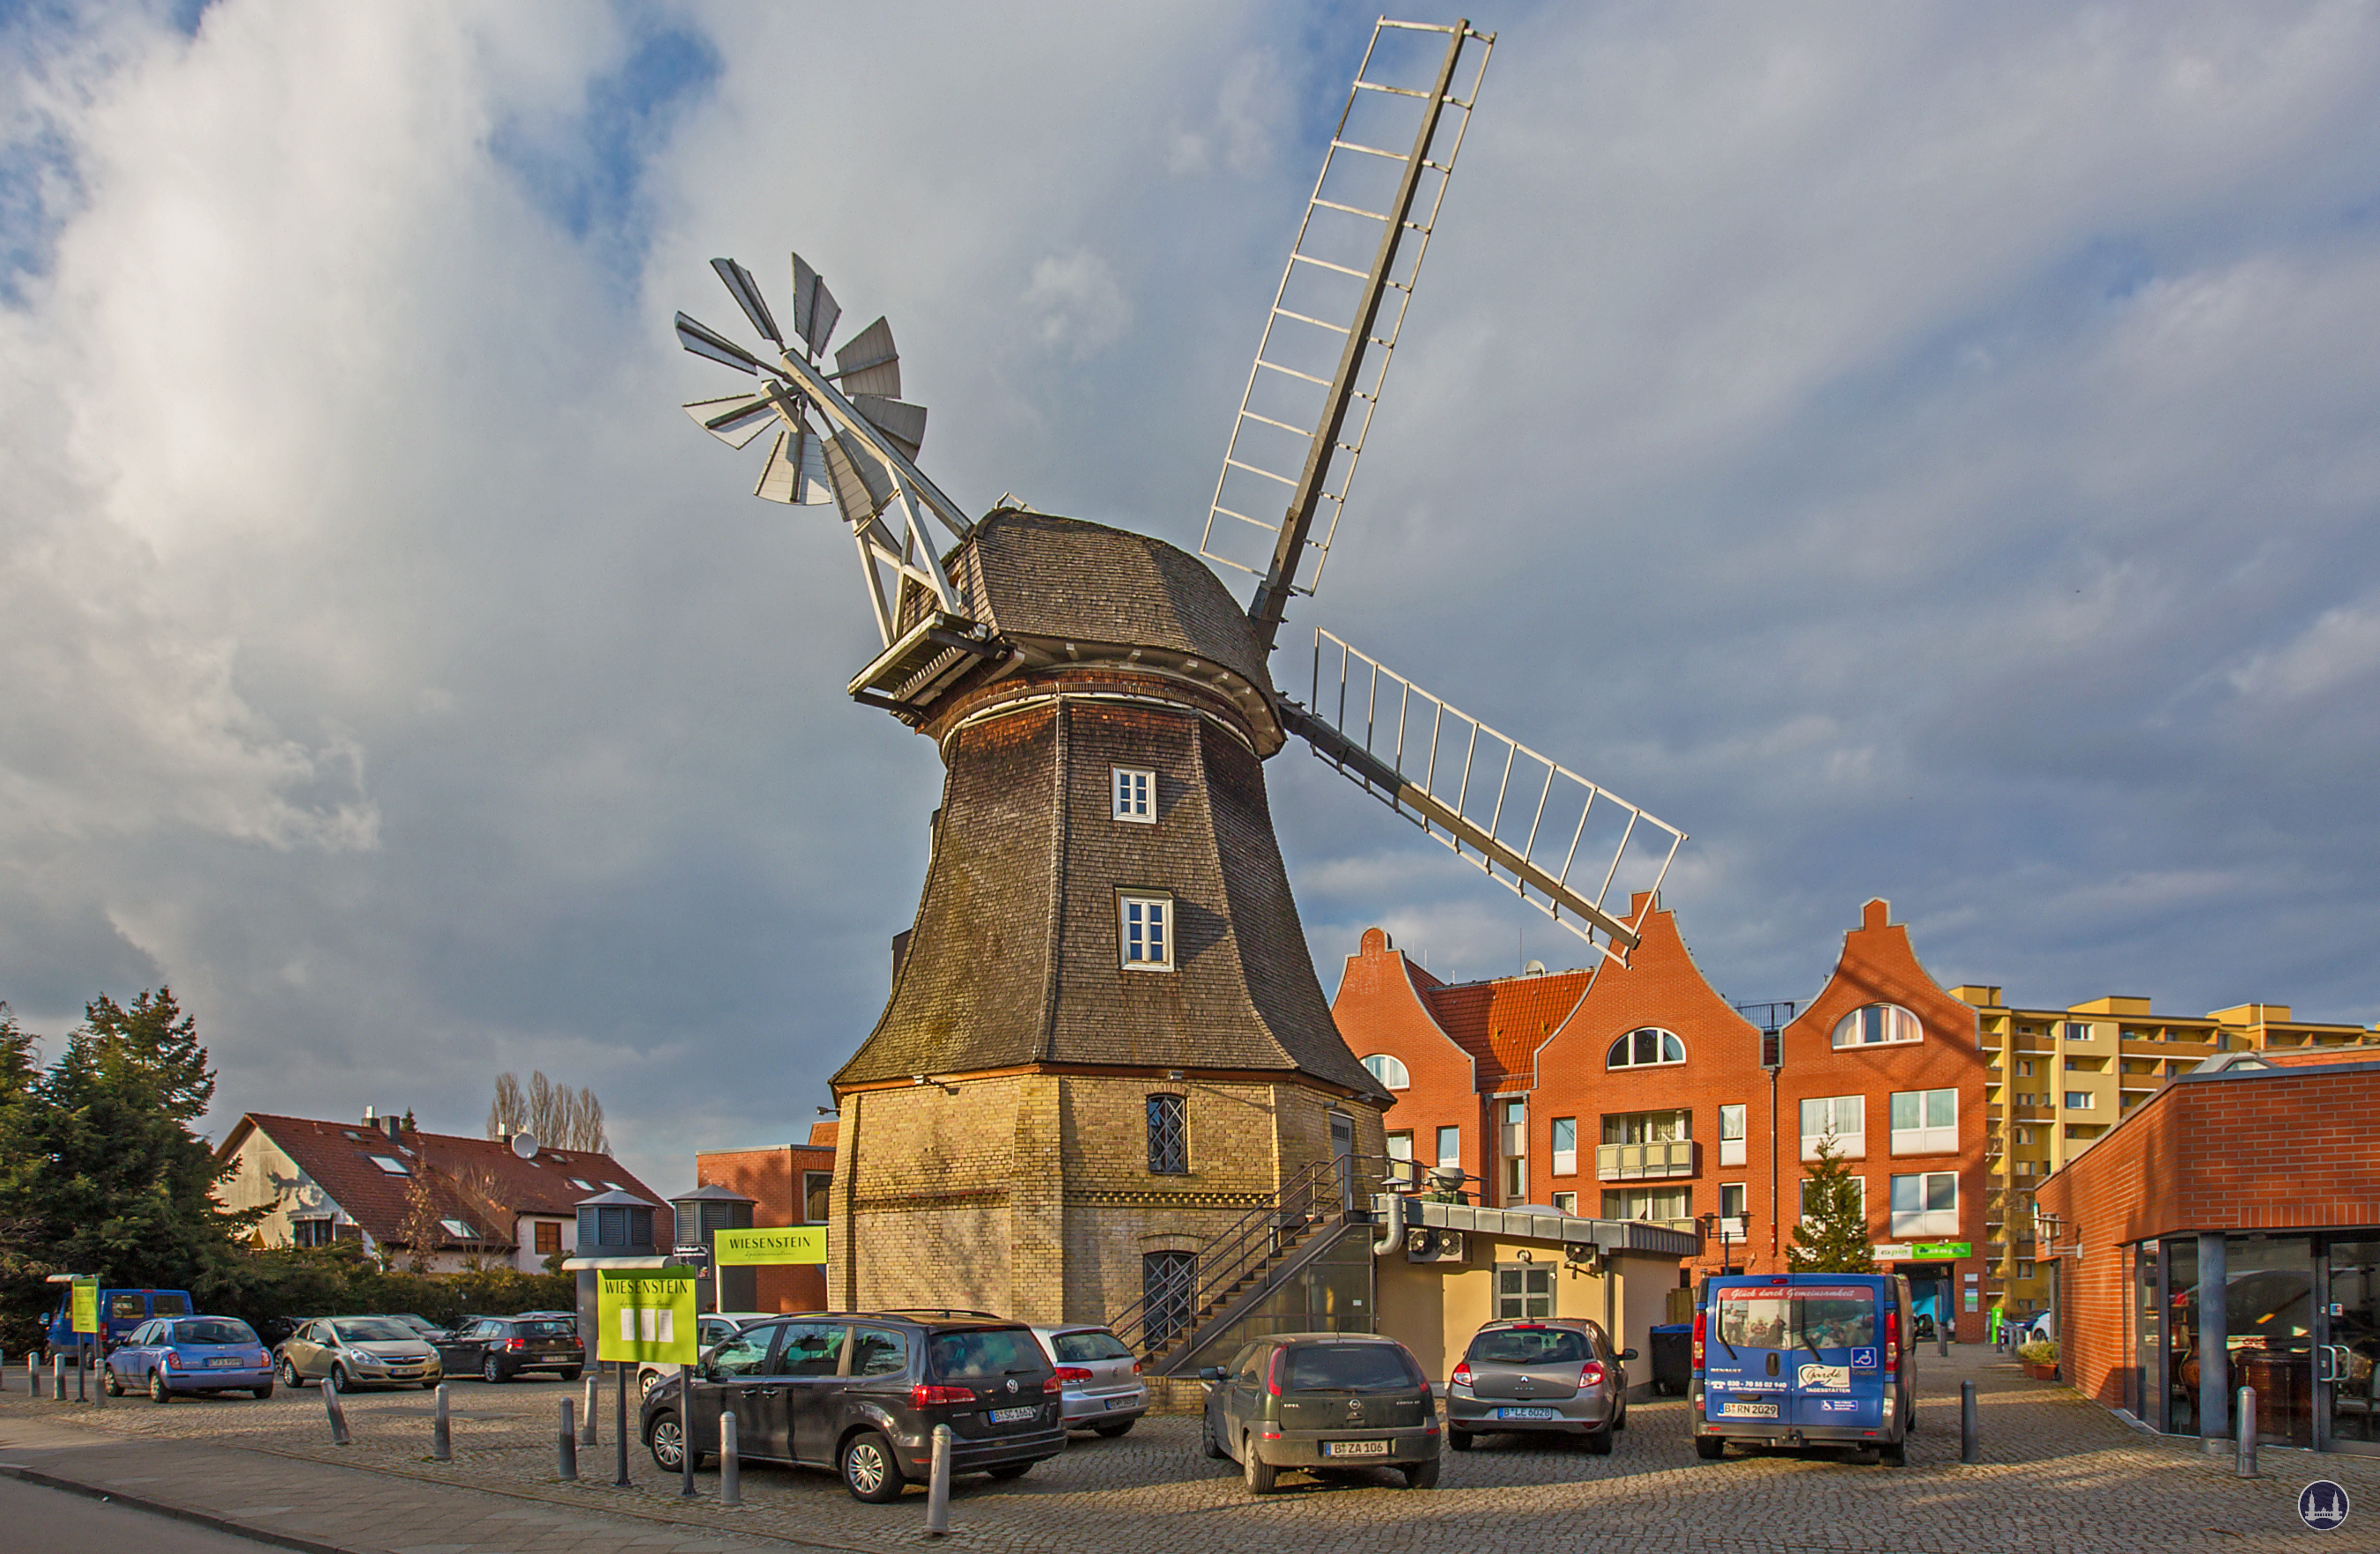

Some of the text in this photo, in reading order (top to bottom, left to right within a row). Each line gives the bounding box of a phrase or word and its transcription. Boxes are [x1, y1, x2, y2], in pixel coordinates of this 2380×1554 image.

[729, 1237, 810, 1249] WIESENSTEIN
[605, 1280, 687, 1294] WIESENSTEIN
[1731, 1287, 1855, 1299] Glück durch Gemeinsamkeit
[994, 1408, 1031, 1420] B SC 1662
[1725, 1404, 1731, 1413] B
[1752, 1405, 1777, 1414] 2029
[1334, 1443, 1383, 1454] B ZA 106
